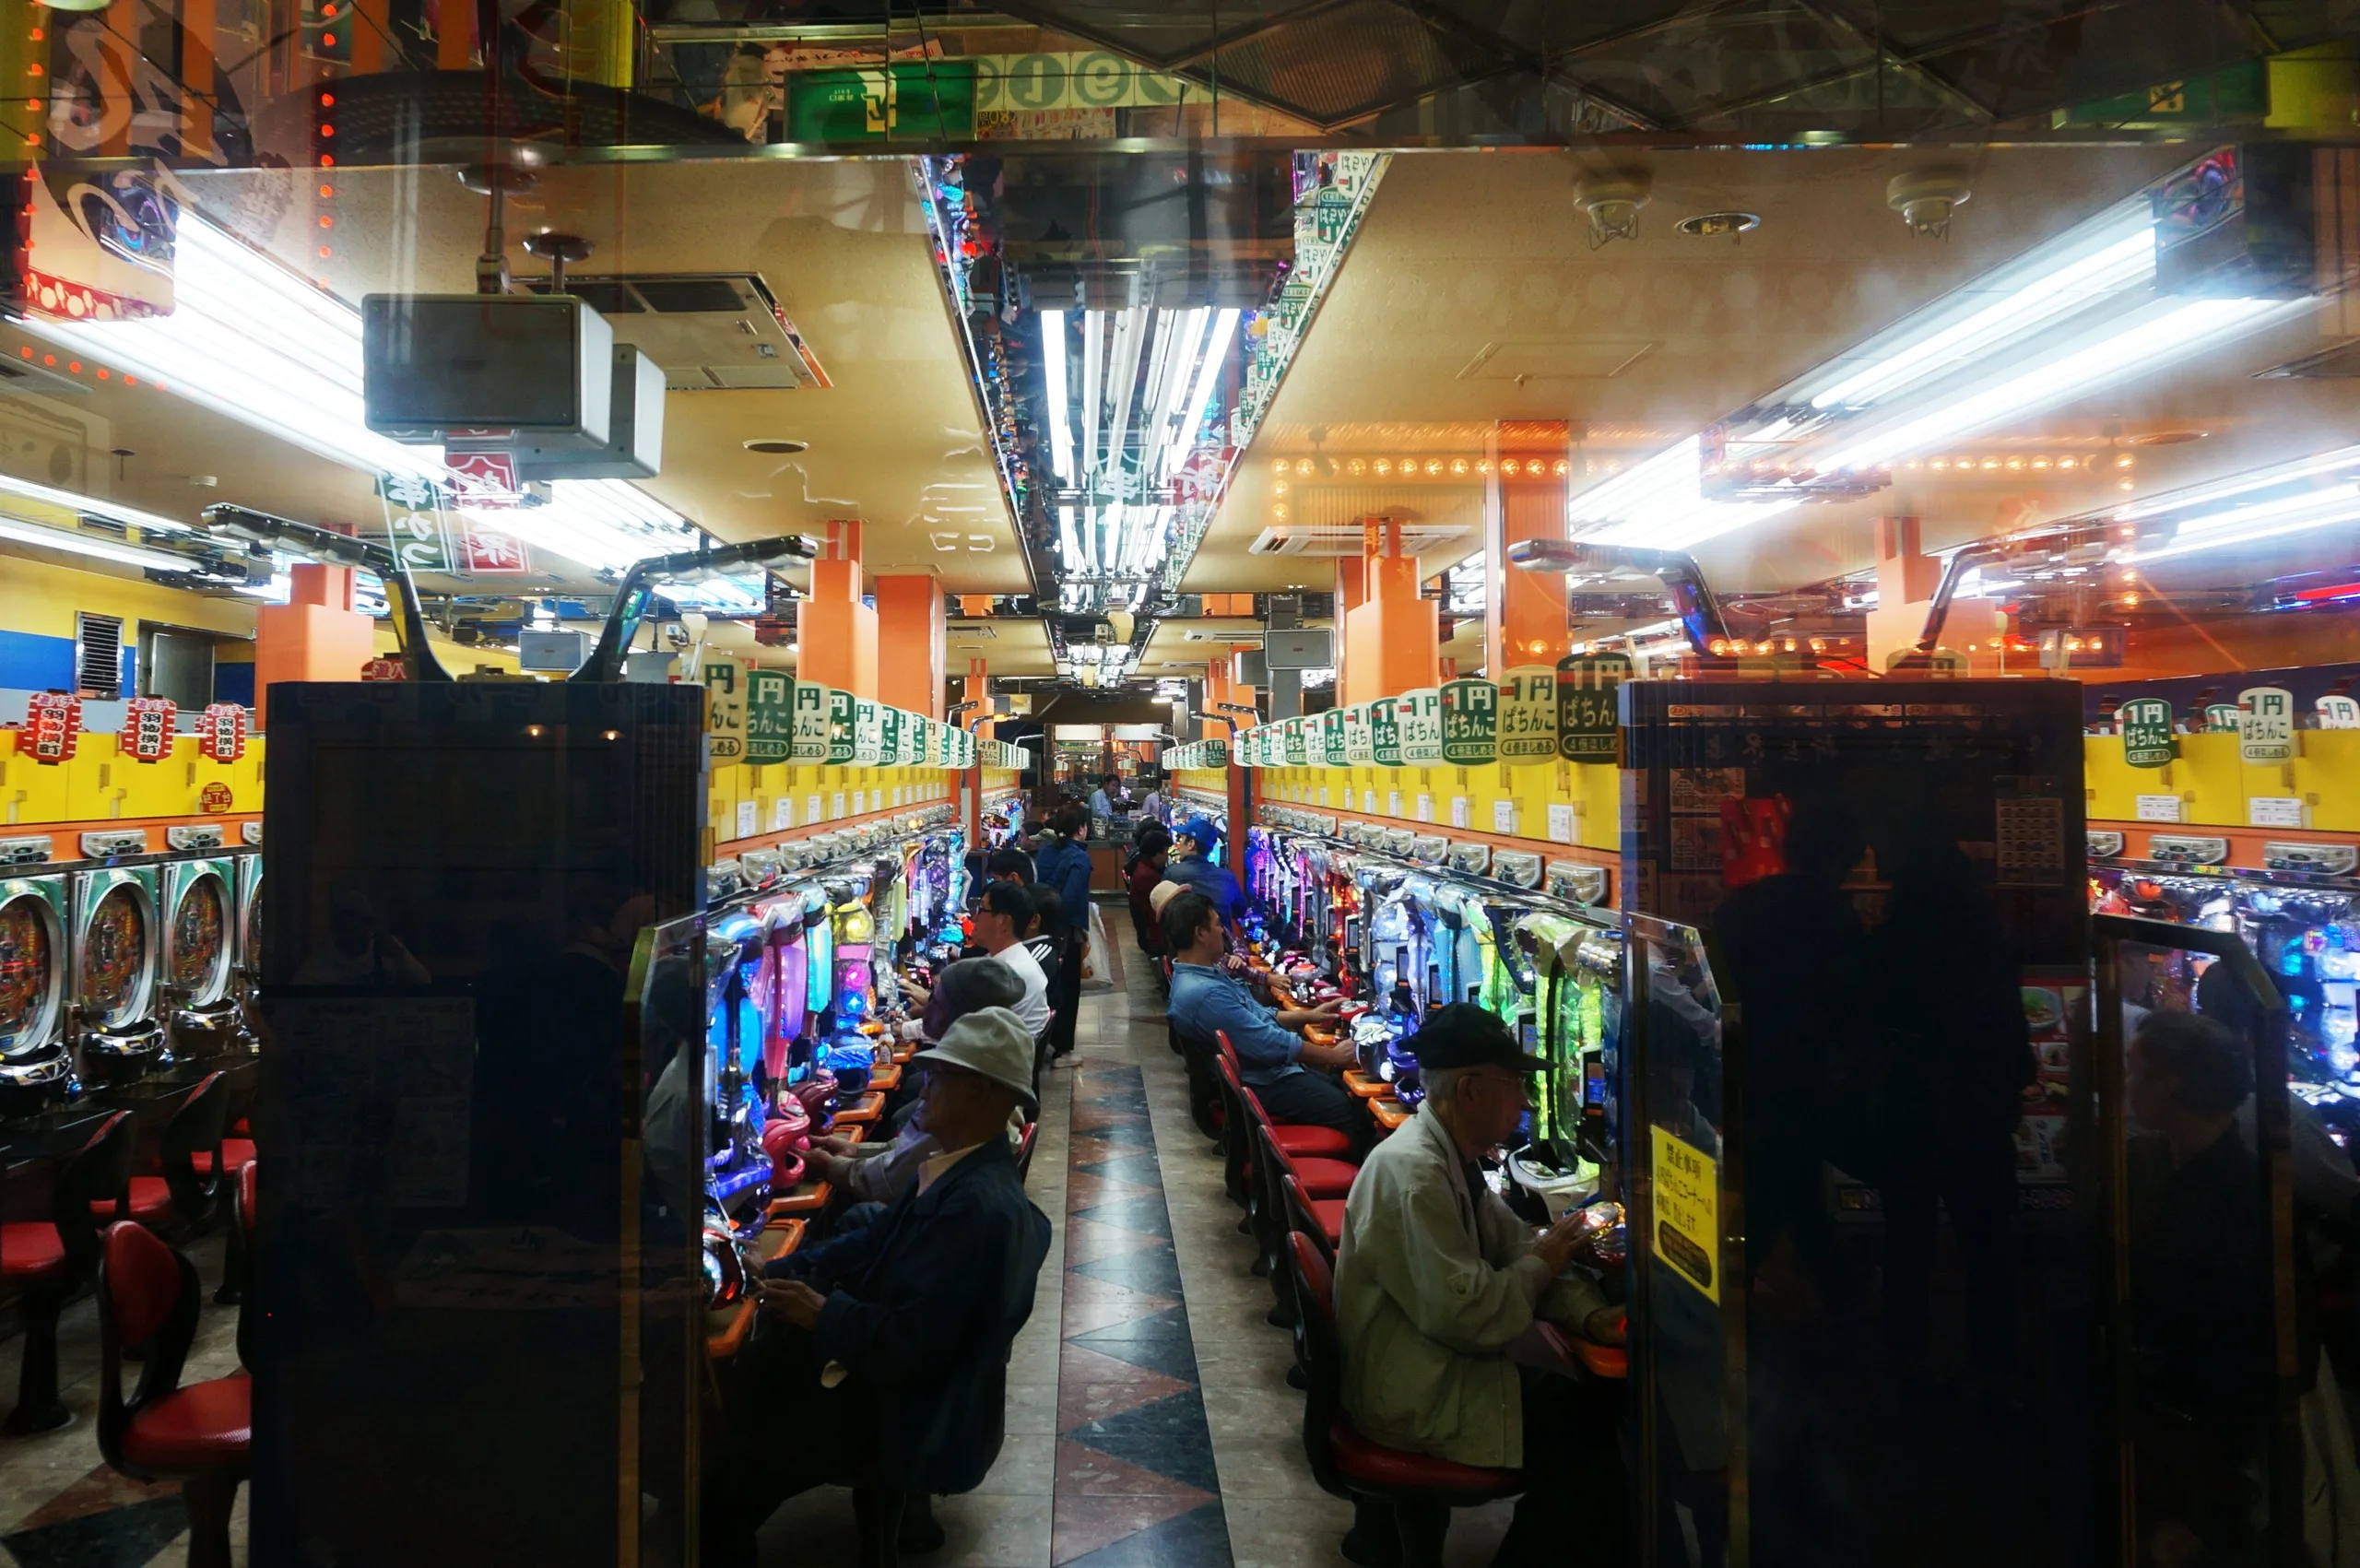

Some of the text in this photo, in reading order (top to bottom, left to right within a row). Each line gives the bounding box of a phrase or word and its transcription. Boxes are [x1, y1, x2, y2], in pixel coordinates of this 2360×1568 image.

[1568, 660, 1626, 690] 1円
[1448, 686, 1493, 710] 1円
[1510, 676, 1553, 701] 1円
[2128, 703, 2164, 725] 1円
[2247, 695, 2283, 715] 1円
[2324, 702, 2354, 721] 1円
[138, 712, 162, 757] 羽物横町
